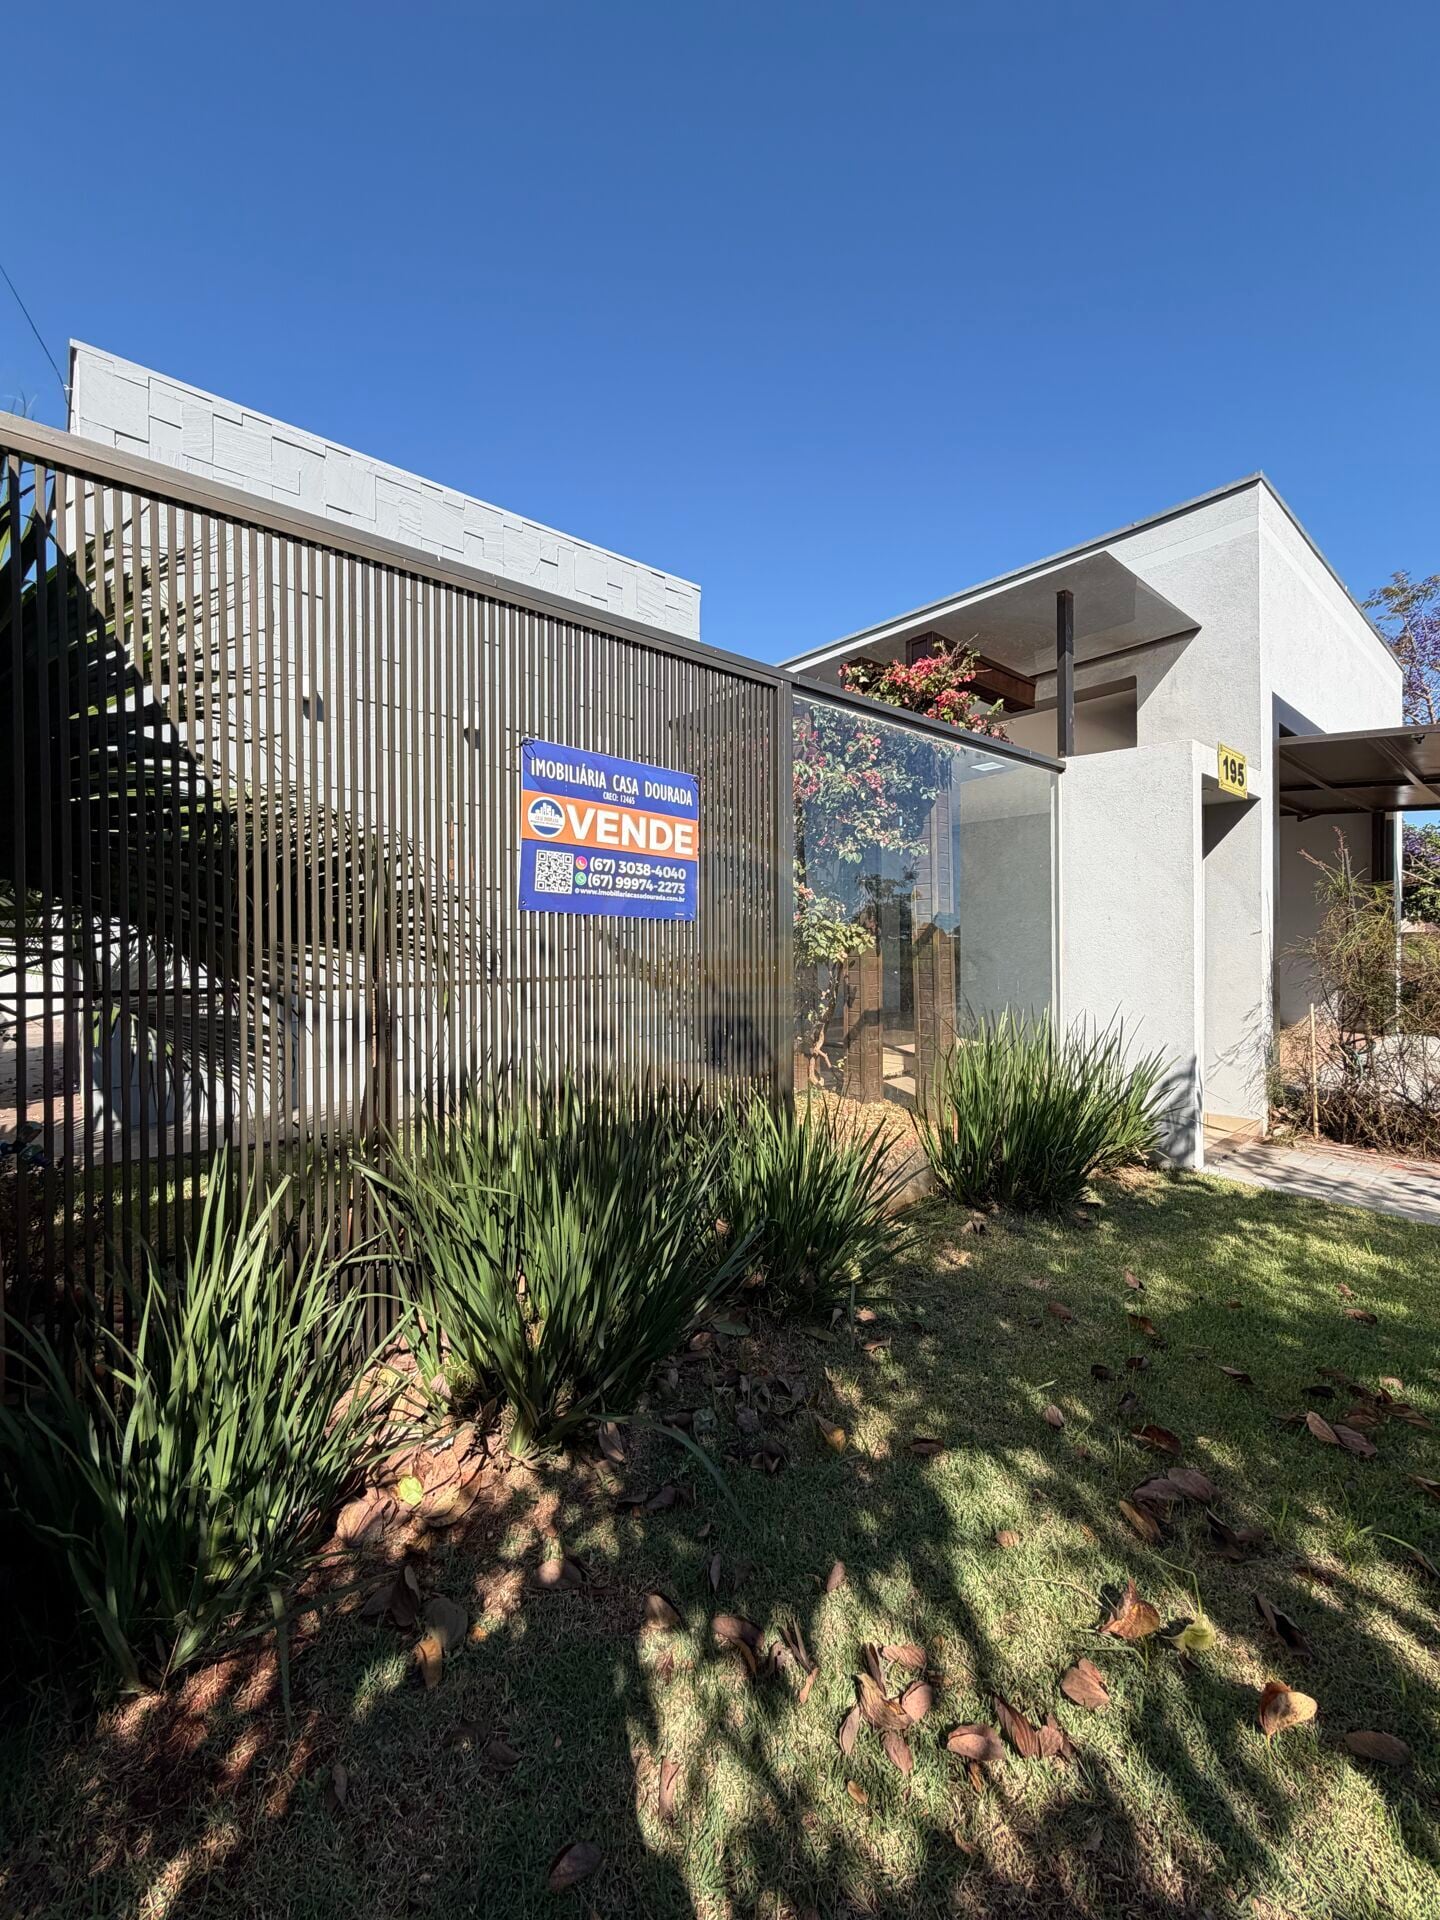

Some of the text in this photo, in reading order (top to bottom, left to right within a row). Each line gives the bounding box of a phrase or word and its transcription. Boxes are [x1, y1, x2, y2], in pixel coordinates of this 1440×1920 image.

[531, 758, 693, 806] IMOBILIÁRIA CASA DOURADA
[1223, 755, 1245, 787] 195
[566, 804, 693, 855] VENDE
[587, 872, 685, 894] (67) 99974-2273
[590, 856, 686, 880] (67) 3038-4040
